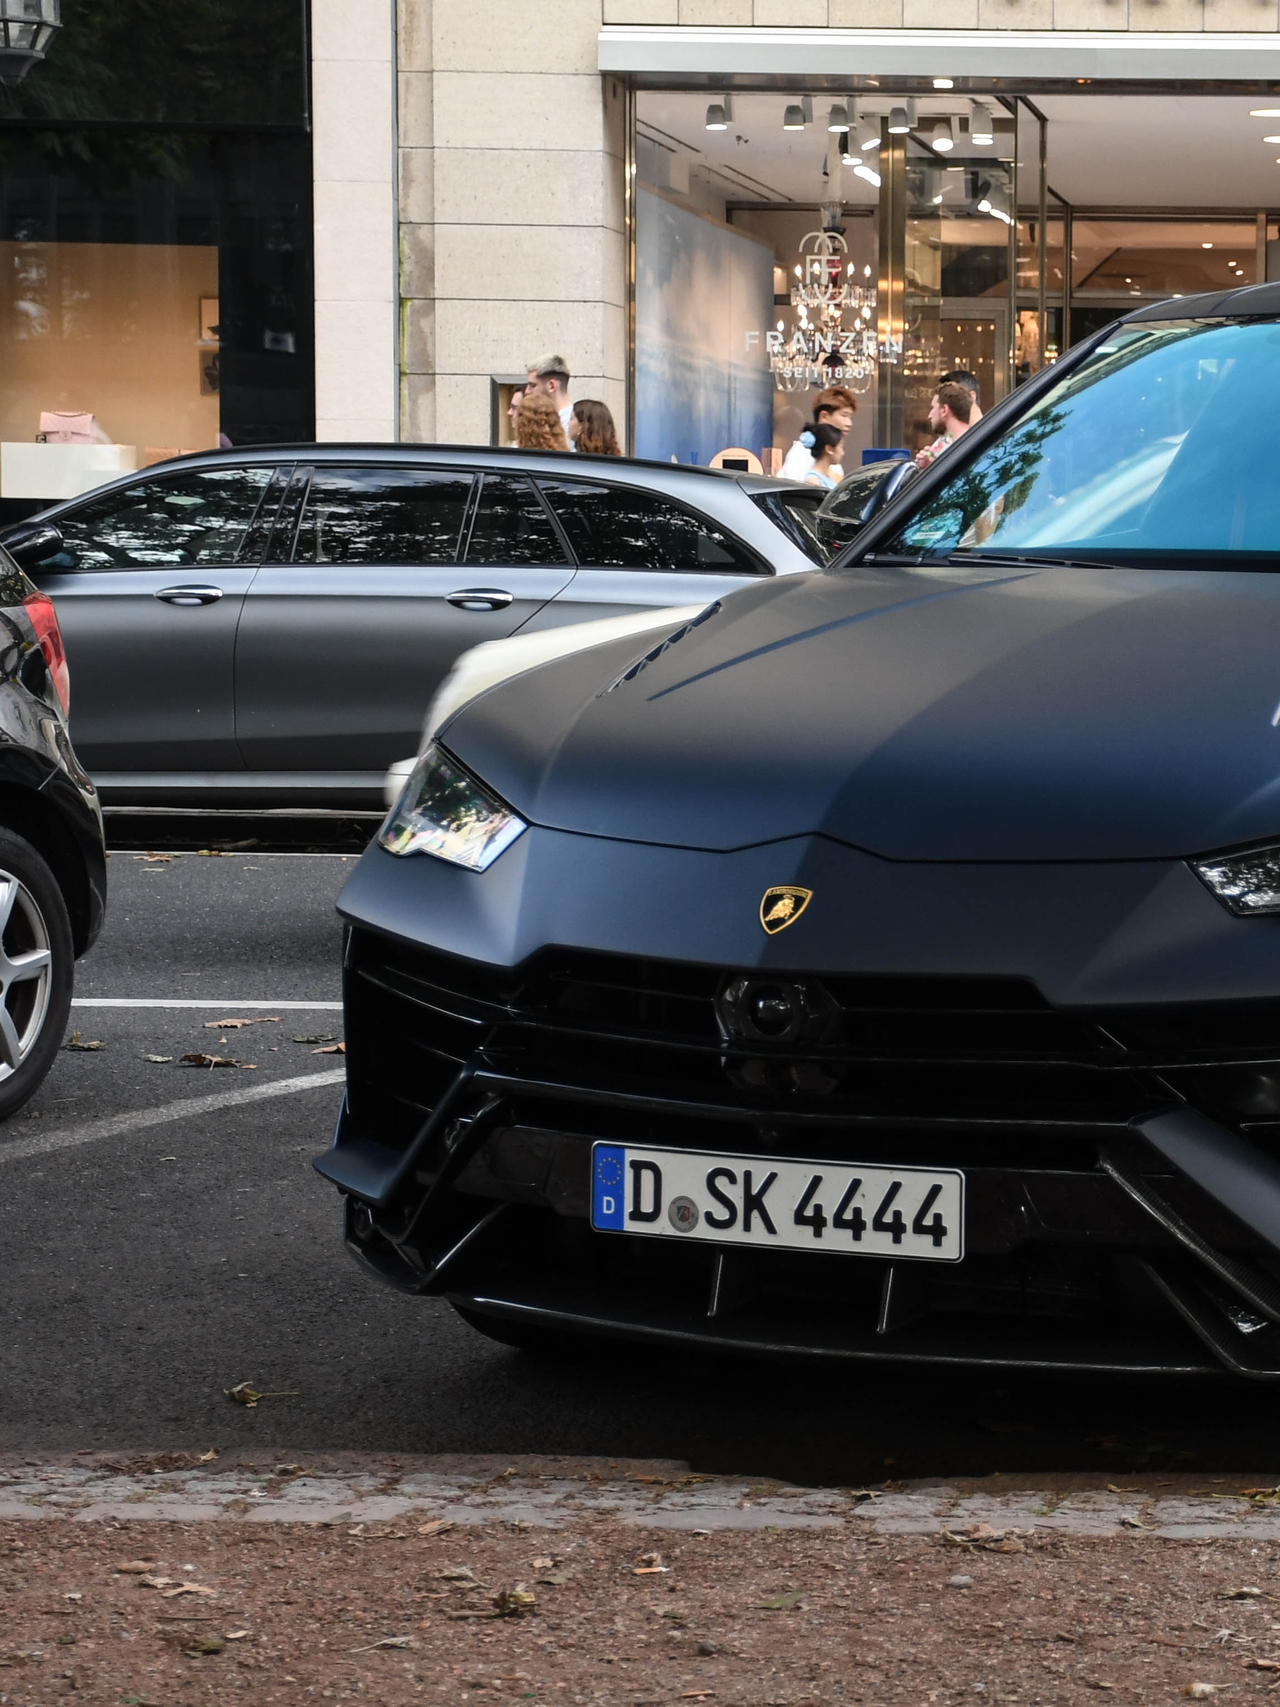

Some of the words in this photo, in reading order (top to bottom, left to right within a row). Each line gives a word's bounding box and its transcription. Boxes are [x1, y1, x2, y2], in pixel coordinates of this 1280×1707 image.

[745, 331, 904, 354] FRANZEN
[783, 367, 819, 378] SEIT
[825, 368, 865, 379] 1820
[602, 1196, 616, 1215] D
[628, 1158, 662, 1223] D
[703, 1166, 778, 1235] SK
[793, 1174, 948, 1248] 4444
